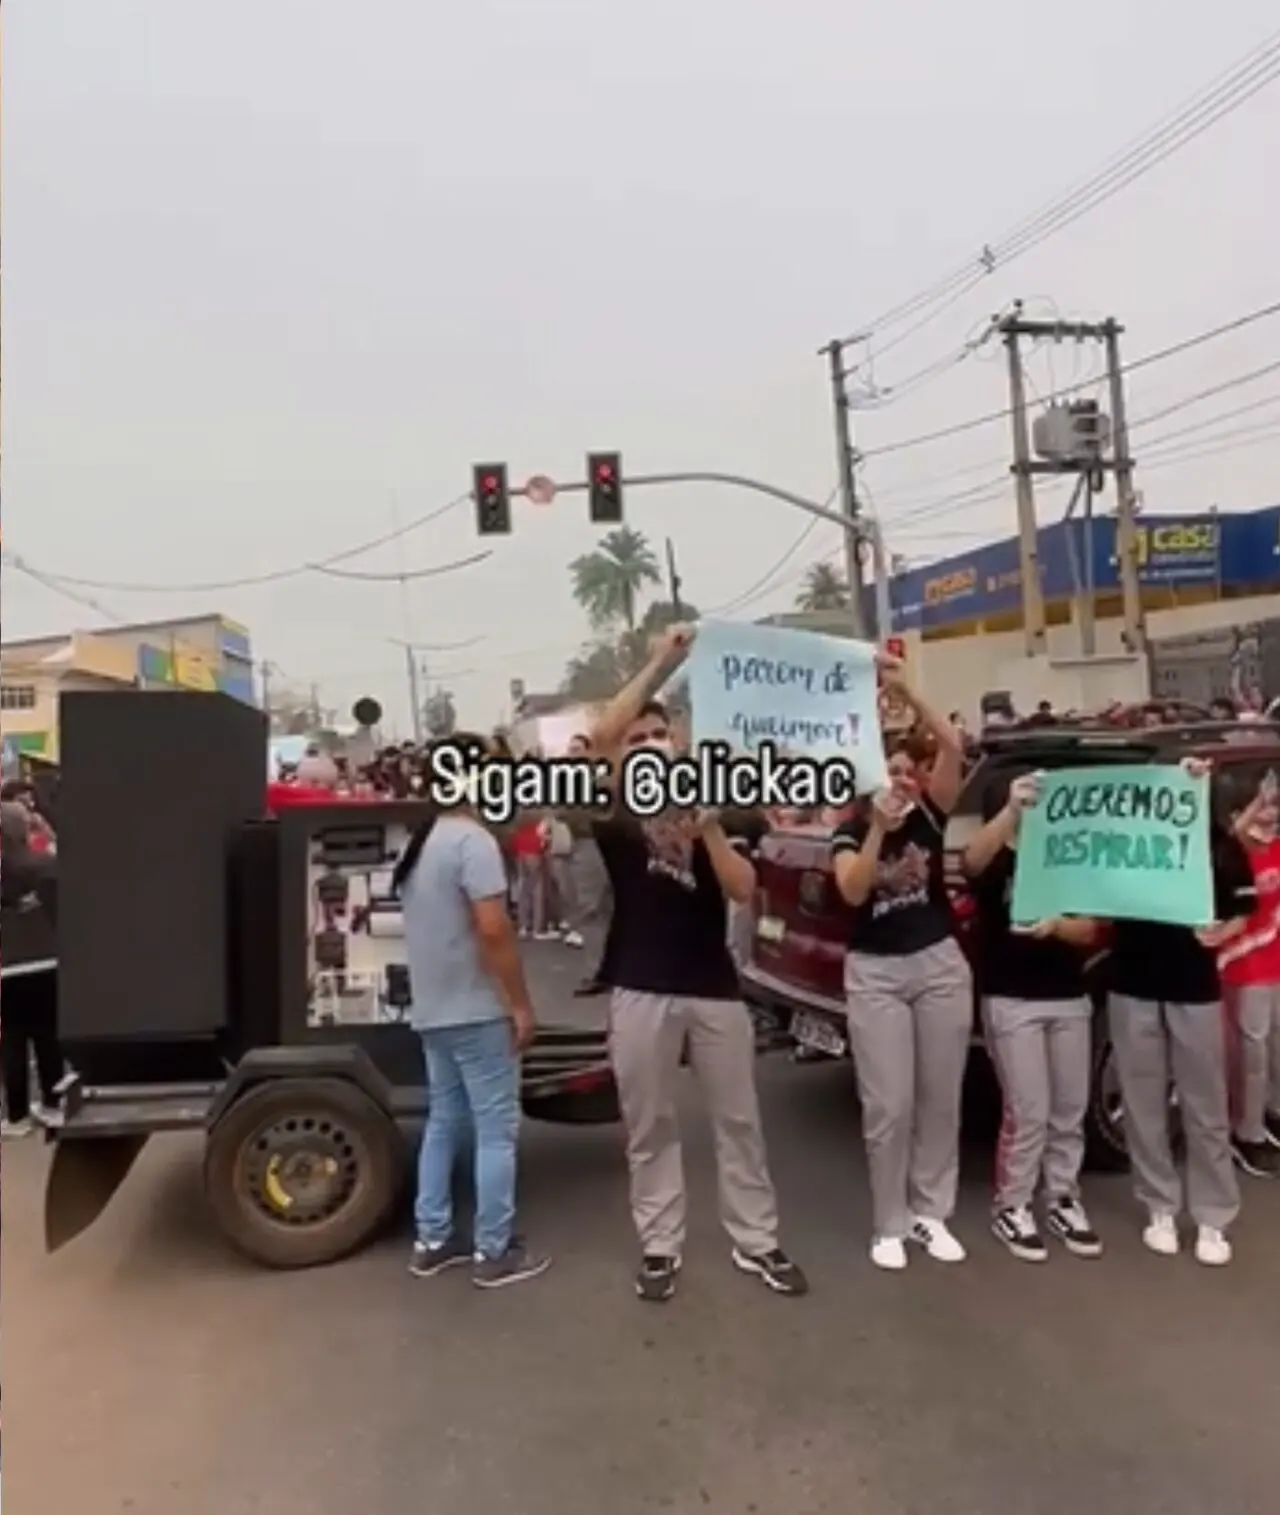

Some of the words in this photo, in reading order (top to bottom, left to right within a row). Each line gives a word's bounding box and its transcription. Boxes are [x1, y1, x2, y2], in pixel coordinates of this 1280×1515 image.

[824, 660, 853, 695] de
[1046, 783, 1199, 828] QUEREMOS
[1043, 829, 1190, 871] RESPIRAR!
